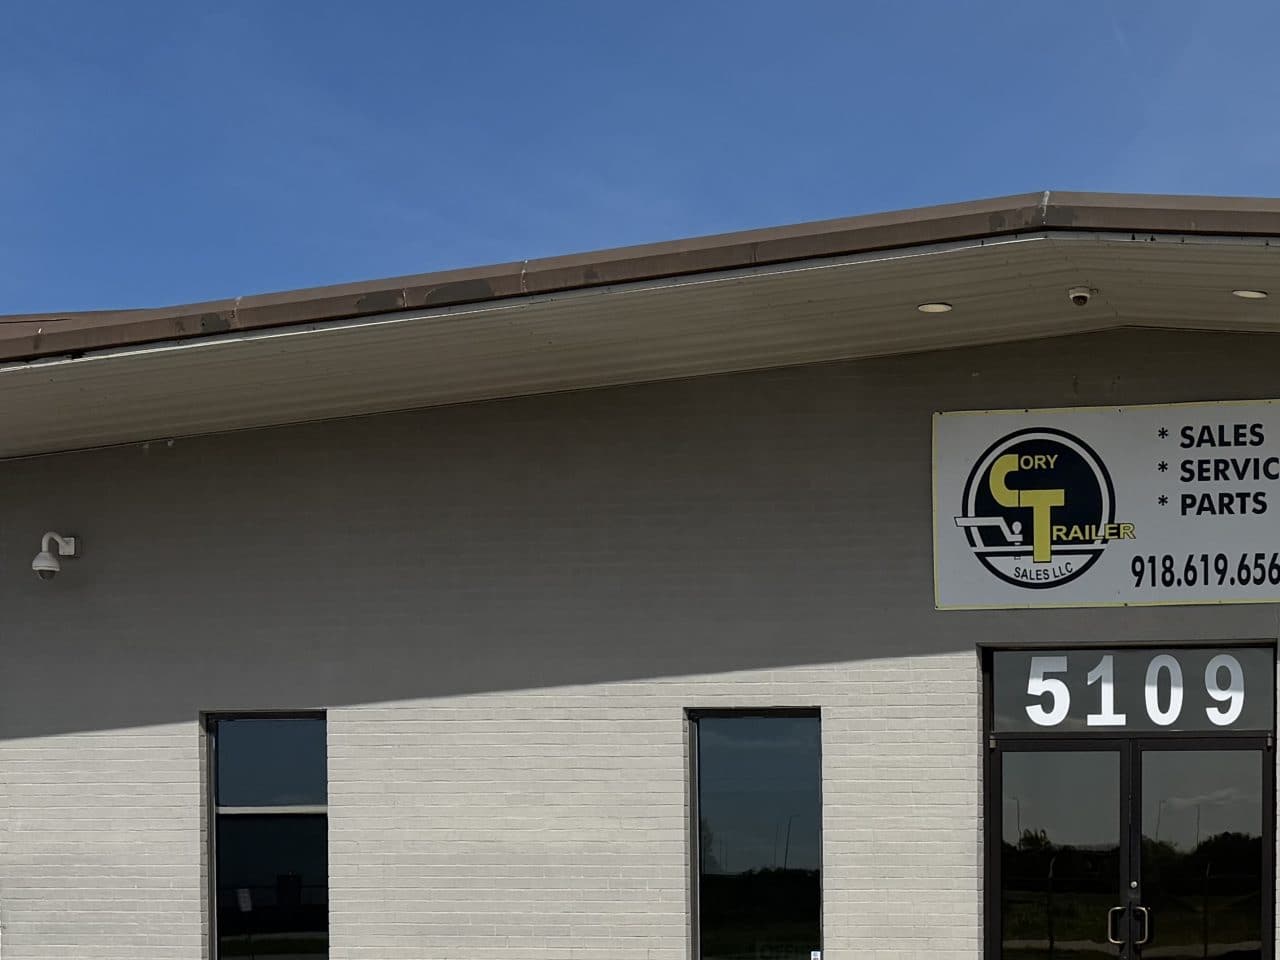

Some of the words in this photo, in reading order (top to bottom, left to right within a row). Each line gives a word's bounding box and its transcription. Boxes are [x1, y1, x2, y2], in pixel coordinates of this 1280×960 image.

[1179, 423, 1265, 449] SALES
[989, 453, 1059, 508] CORY
[1180, 491, 1268, 516] PARTS
[1019, 488, 1137, 563] TRAILER
[1013, 566, 1050, 581] SALES
[1052, 561, 1074, 579] LLC
[1025, 653, 1245, 727] 5109
